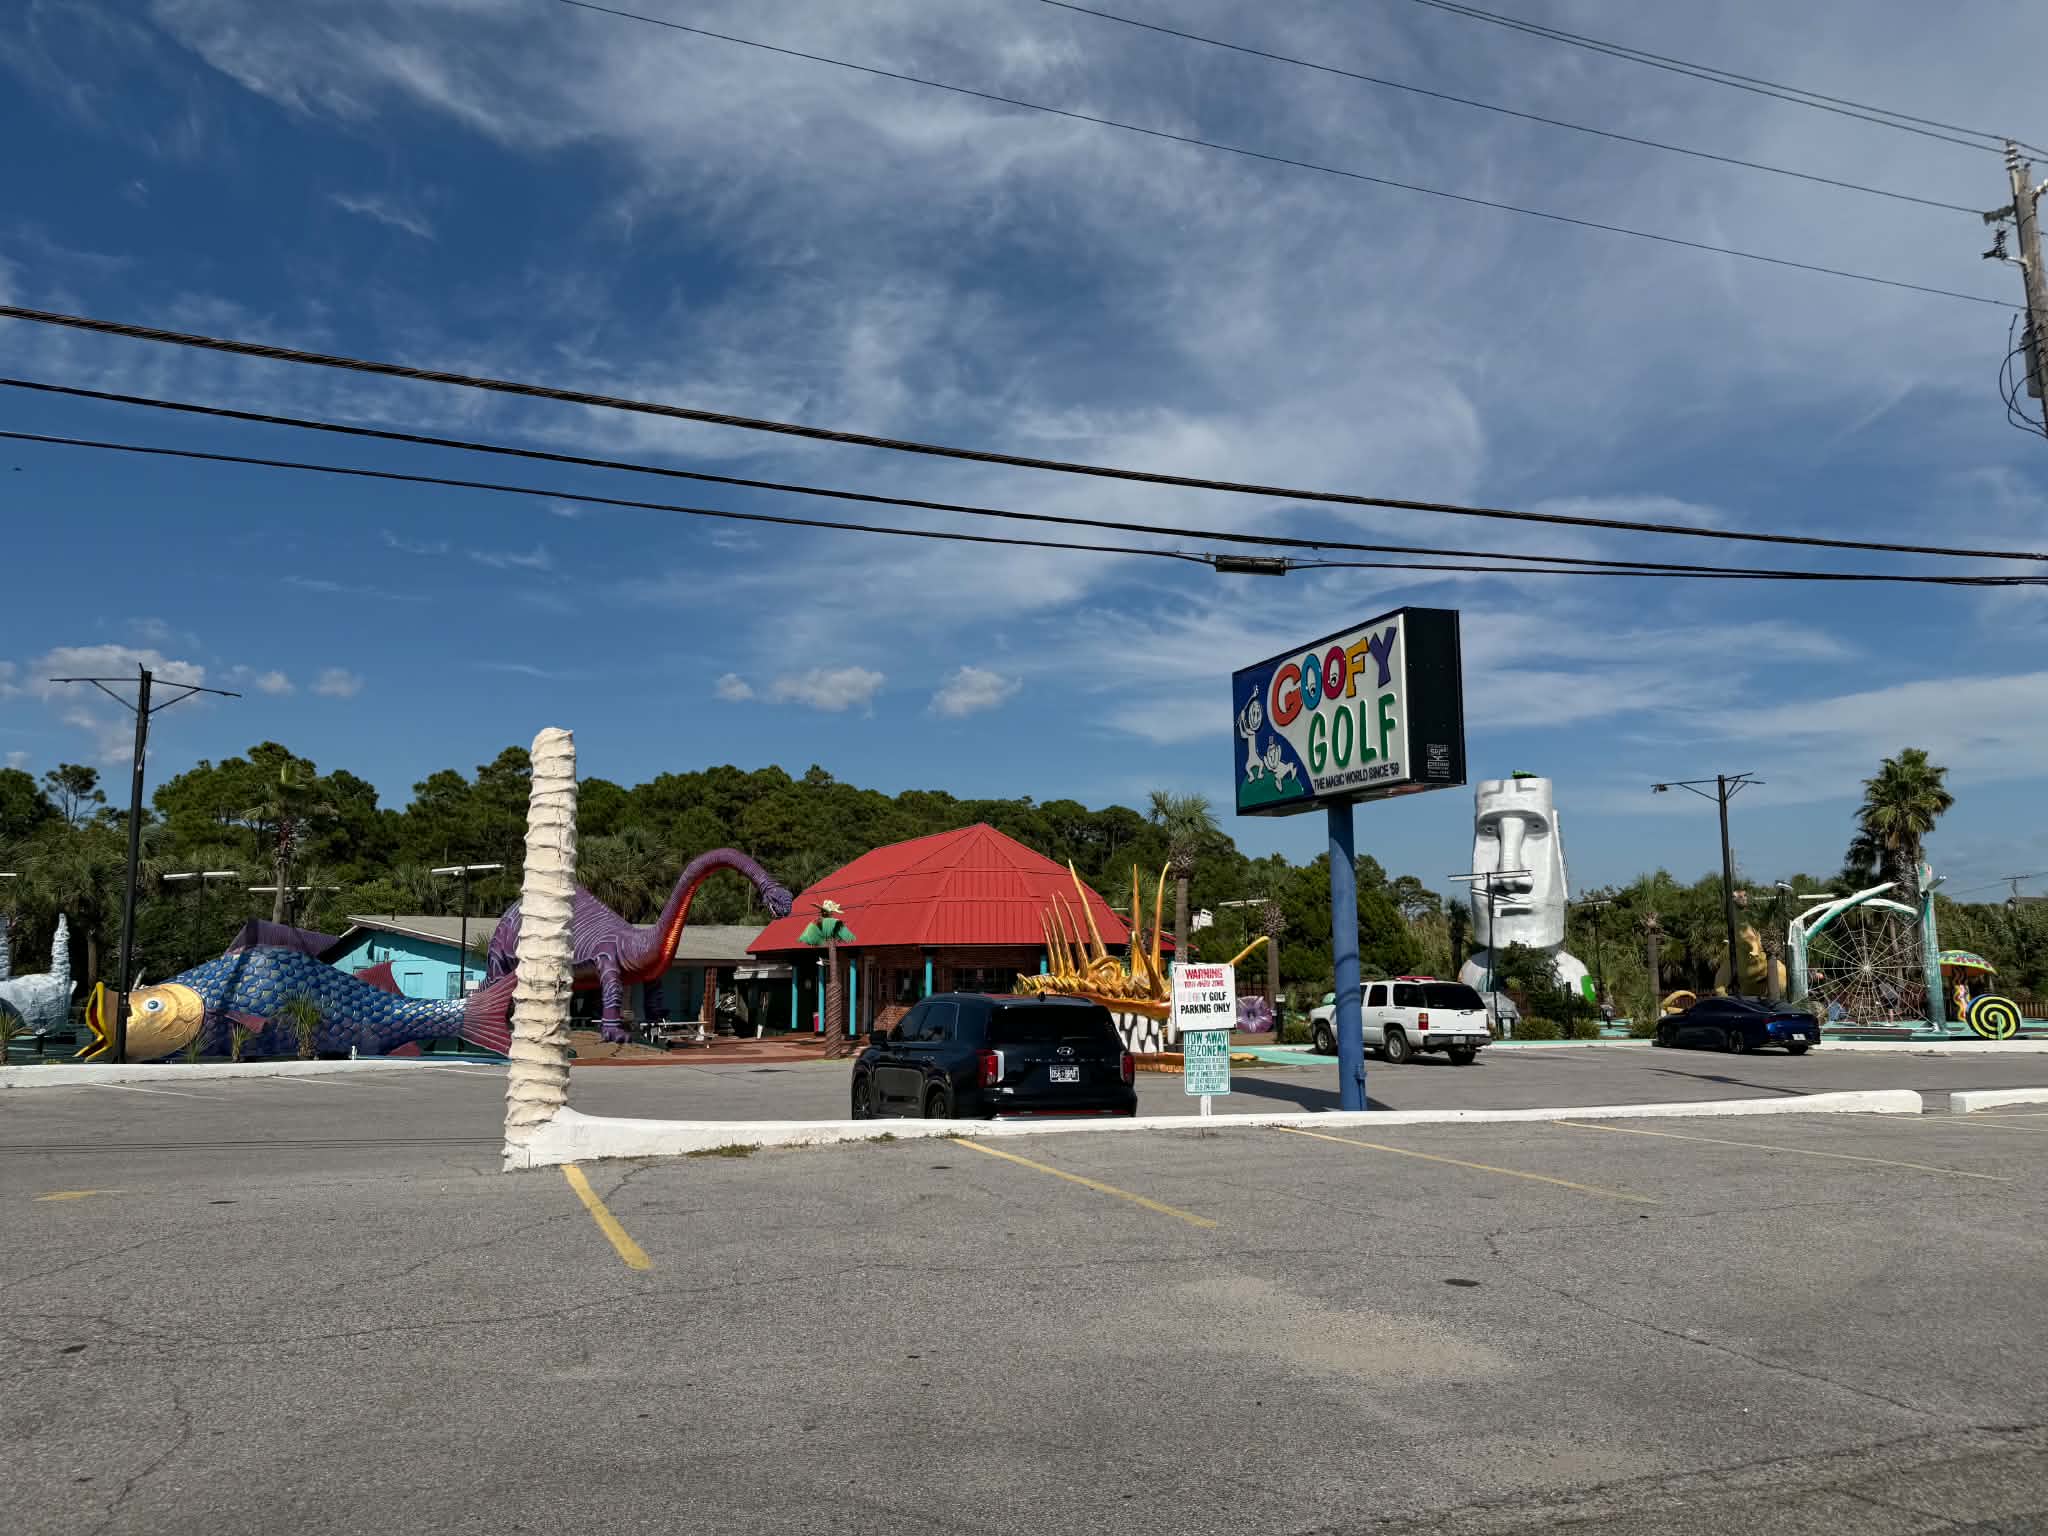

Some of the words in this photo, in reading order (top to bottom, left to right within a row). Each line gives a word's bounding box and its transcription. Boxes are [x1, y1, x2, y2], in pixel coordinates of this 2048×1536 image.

[1271, 627, 1397, 727] GOOFY
[1308, 692, 1397, 774] GOLF
[1313, 776, 1325, 790] THE
[1325, 774, 1345, 789] MAGIC
[1345, 769, 1368, 784] WORLD
[1368, 764, 1389, 780] SINCE
[1185, 968, 1223, 979] WARNING
[1209, 991, 1227, 1002] GOLF
[1180, 1003, 1212, 1015] PARKING
[1213, 1002, 1231, 1013] ONLY
[1186, 1031, 1203, 1045] TOW
[1205, 1031, 1227, 1045] AWAY
[1196, 1044, 1217, 1057] ZONE
